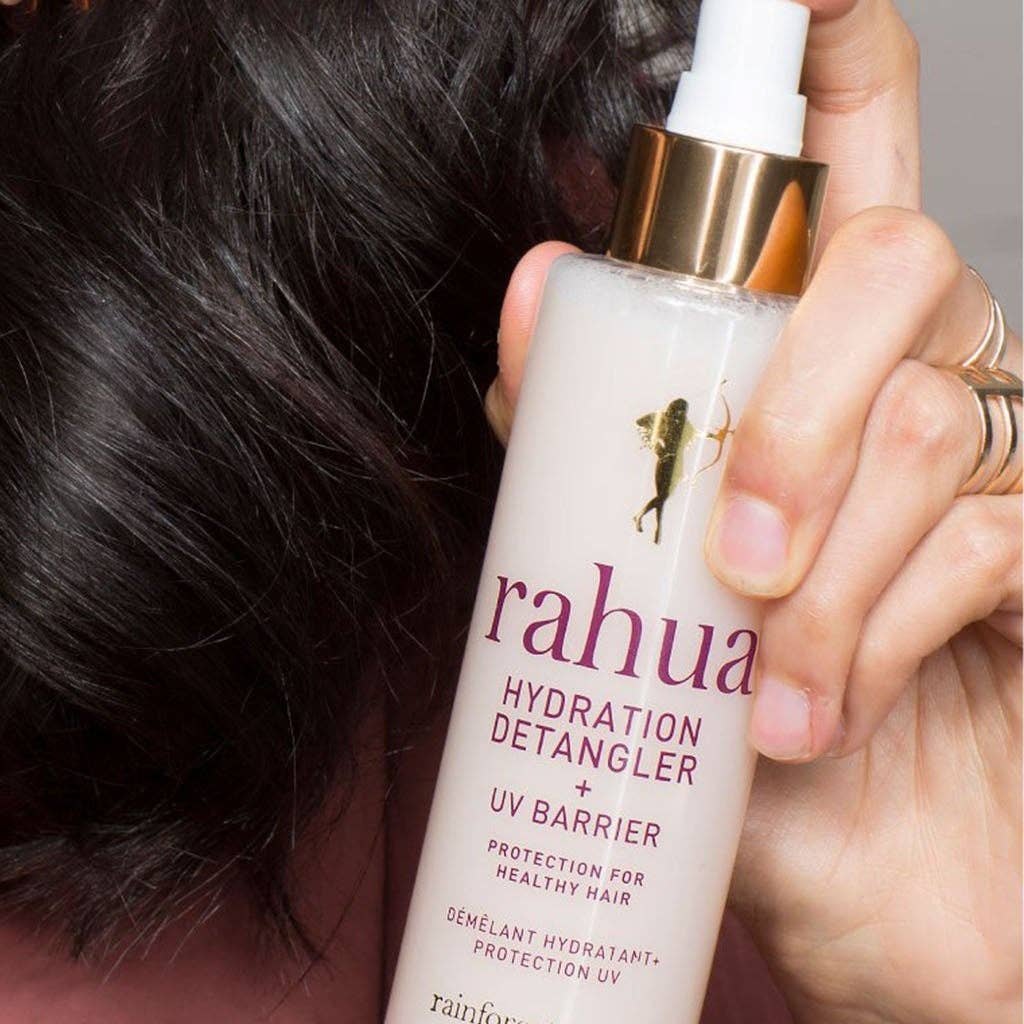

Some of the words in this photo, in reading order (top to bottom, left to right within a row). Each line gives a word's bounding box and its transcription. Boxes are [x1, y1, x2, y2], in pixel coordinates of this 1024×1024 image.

[484, 562, 758, 695] rahua
[502, 675, 702, 747] HYDRATION
[491, 712, 698, 785] DETANGLER
[575, 780, 592, 798] +
[490, 787, 524, 817] UV
[532, 799, 661, 848] BARRIER
[487, 839, 603, 879] PROTECTION
[610, 868, 645, 887] FOR
[496, 864, 579, 896] HEALTHY
[586, 885, 631, 906] HAIR
[447, 906, 537, 945] DÉMÊLANT
[473, 939, 590, 980] PROTECTION
[597, 967, 621, 985] UV
